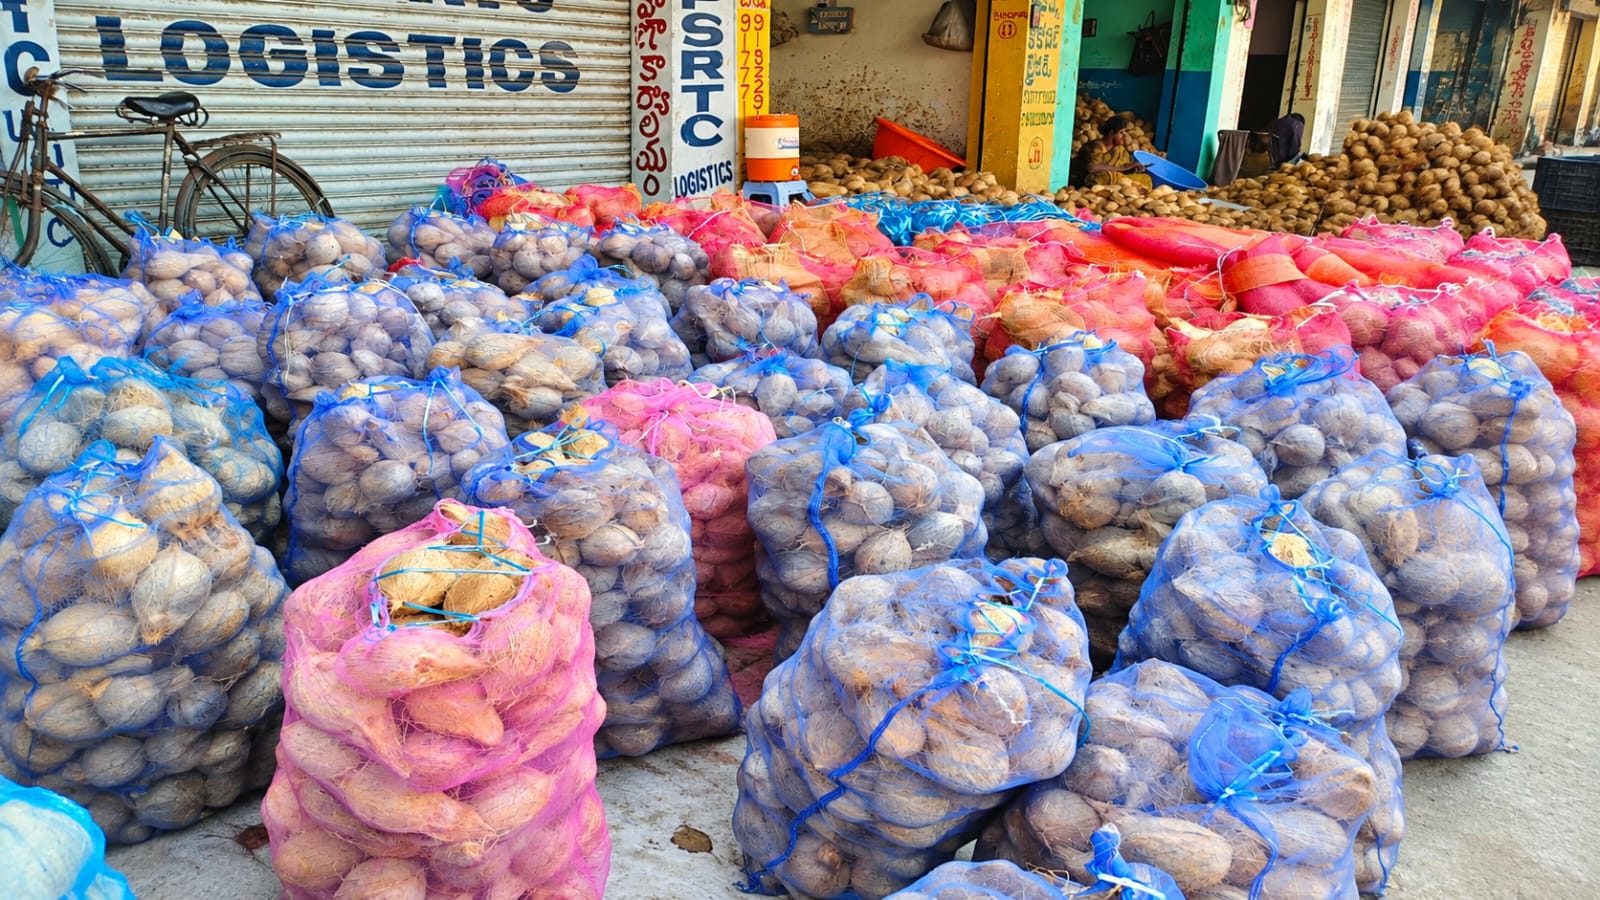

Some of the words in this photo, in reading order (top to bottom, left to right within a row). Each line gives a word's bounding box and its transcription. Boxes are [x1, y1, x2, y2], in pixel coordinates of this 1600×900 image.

[96, 15, 581, 94] LOGISTICS
[680, 0, 725, 147] SRTC
[673, 159, 734, 198] LOGISTICS
